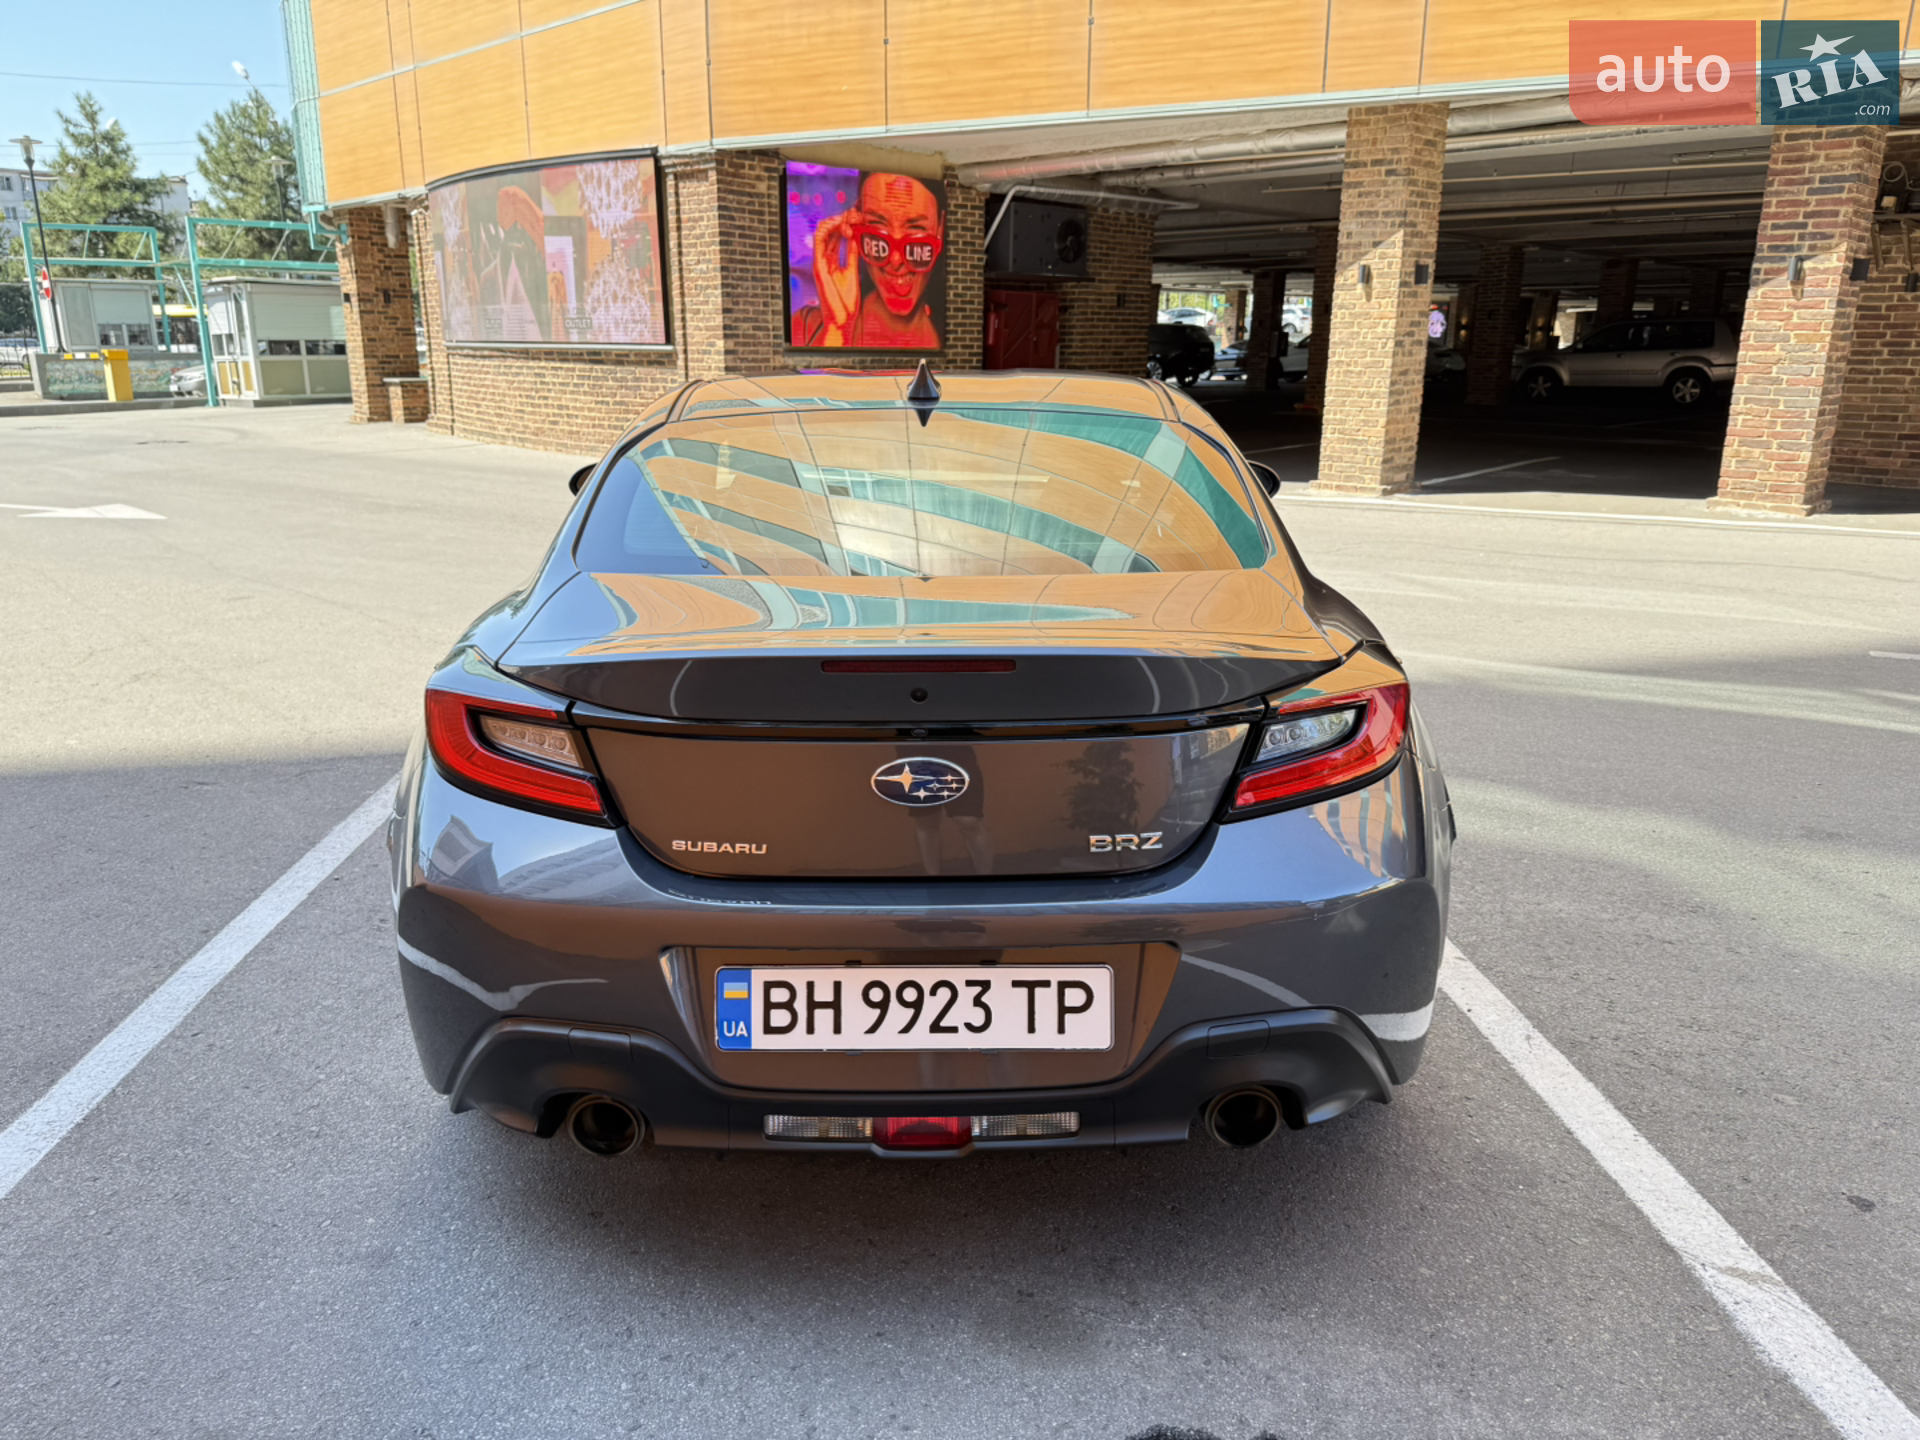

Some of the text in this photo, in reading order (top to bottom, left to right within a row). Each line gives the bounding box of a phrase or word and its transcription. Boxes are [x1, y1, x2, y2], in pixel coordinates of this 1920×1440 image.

[863, 237, 932, 262] RED LINE
[564, 319, 591, 328] OUTLET
[671, 840, 768, 855] SUBARU
[1089, 831, 1163, 853] BRZ
[763, 979, 1095, 1035] BH 9923 TP
[723, 1020, 749, 1038] UA
